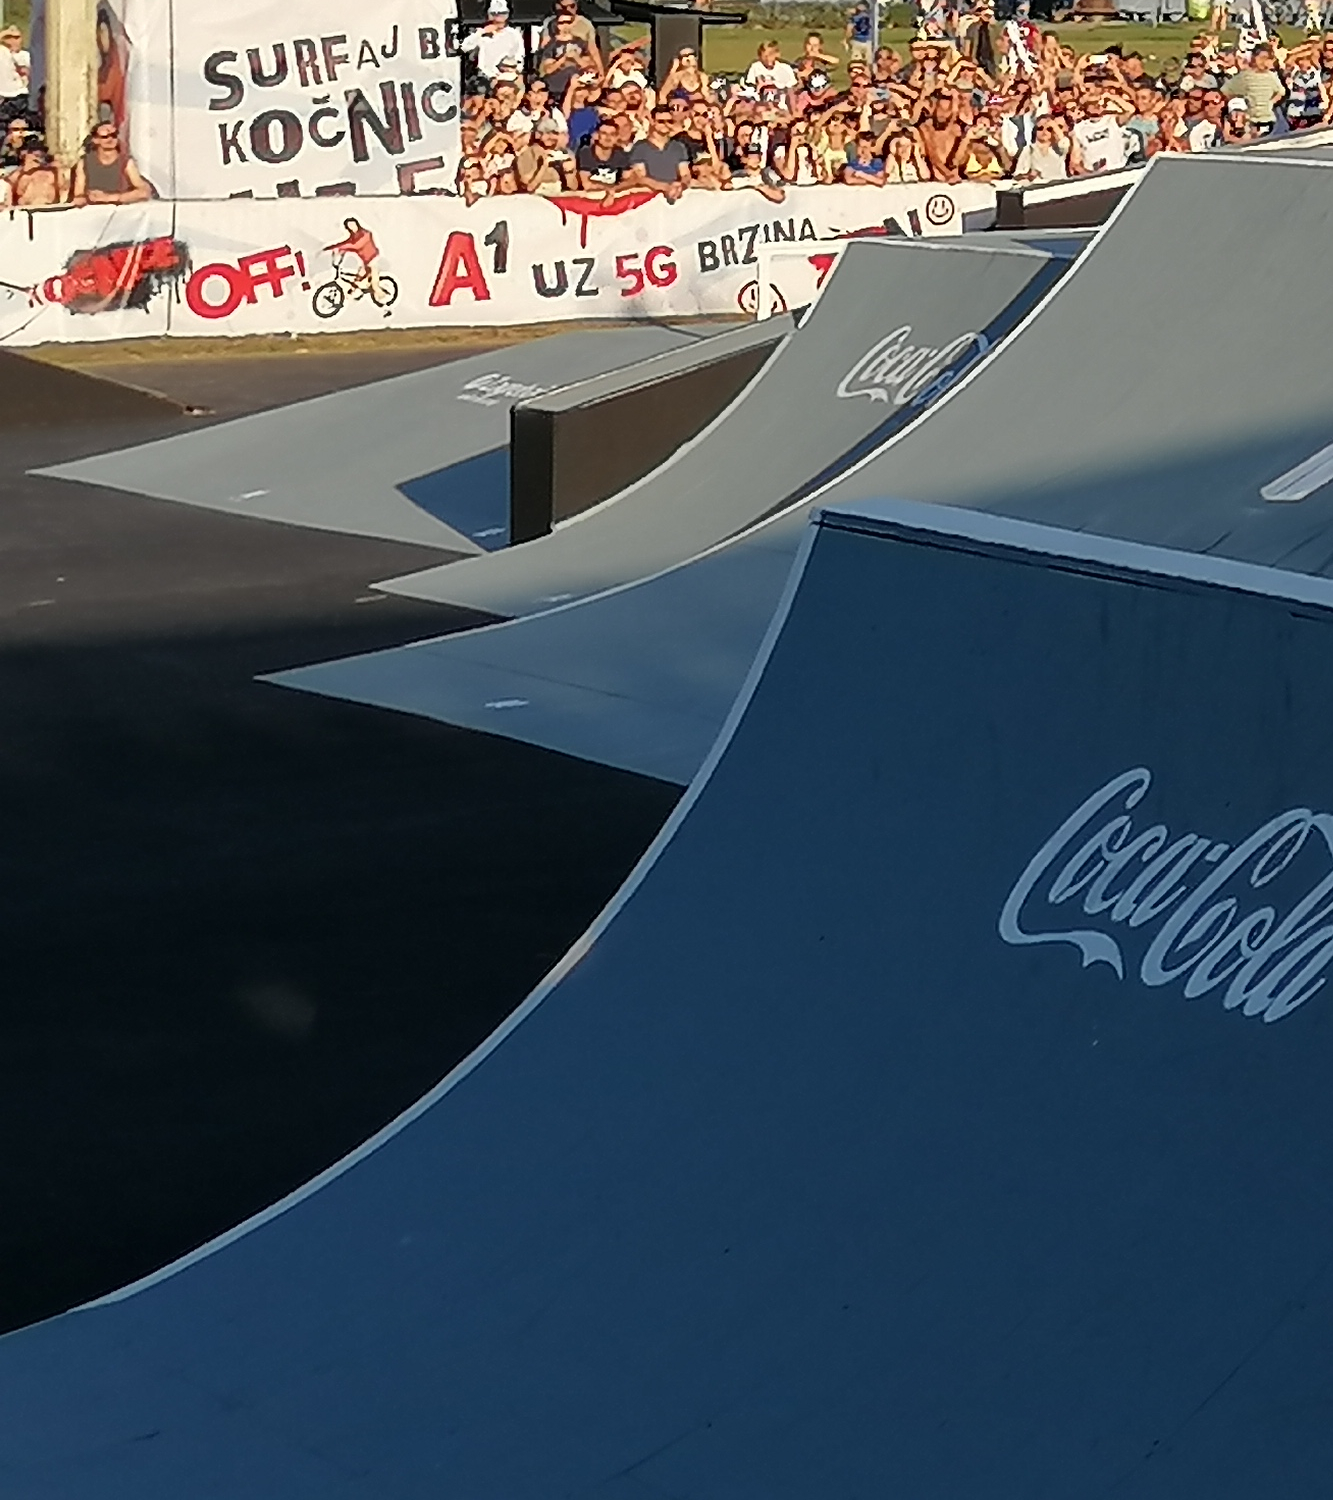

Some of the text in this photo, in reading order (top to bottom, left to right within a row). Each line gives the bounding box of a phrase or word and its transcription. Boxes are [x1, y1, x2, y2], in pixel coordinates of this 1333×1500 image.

[218, 81, 458, 165] KOČNIC
[185, 245, 311, 319] OFF!
[428, 220, 509, 307] A1
[532, 258, 599, 298] UZ
[614, 245, 678, 298] 5G
